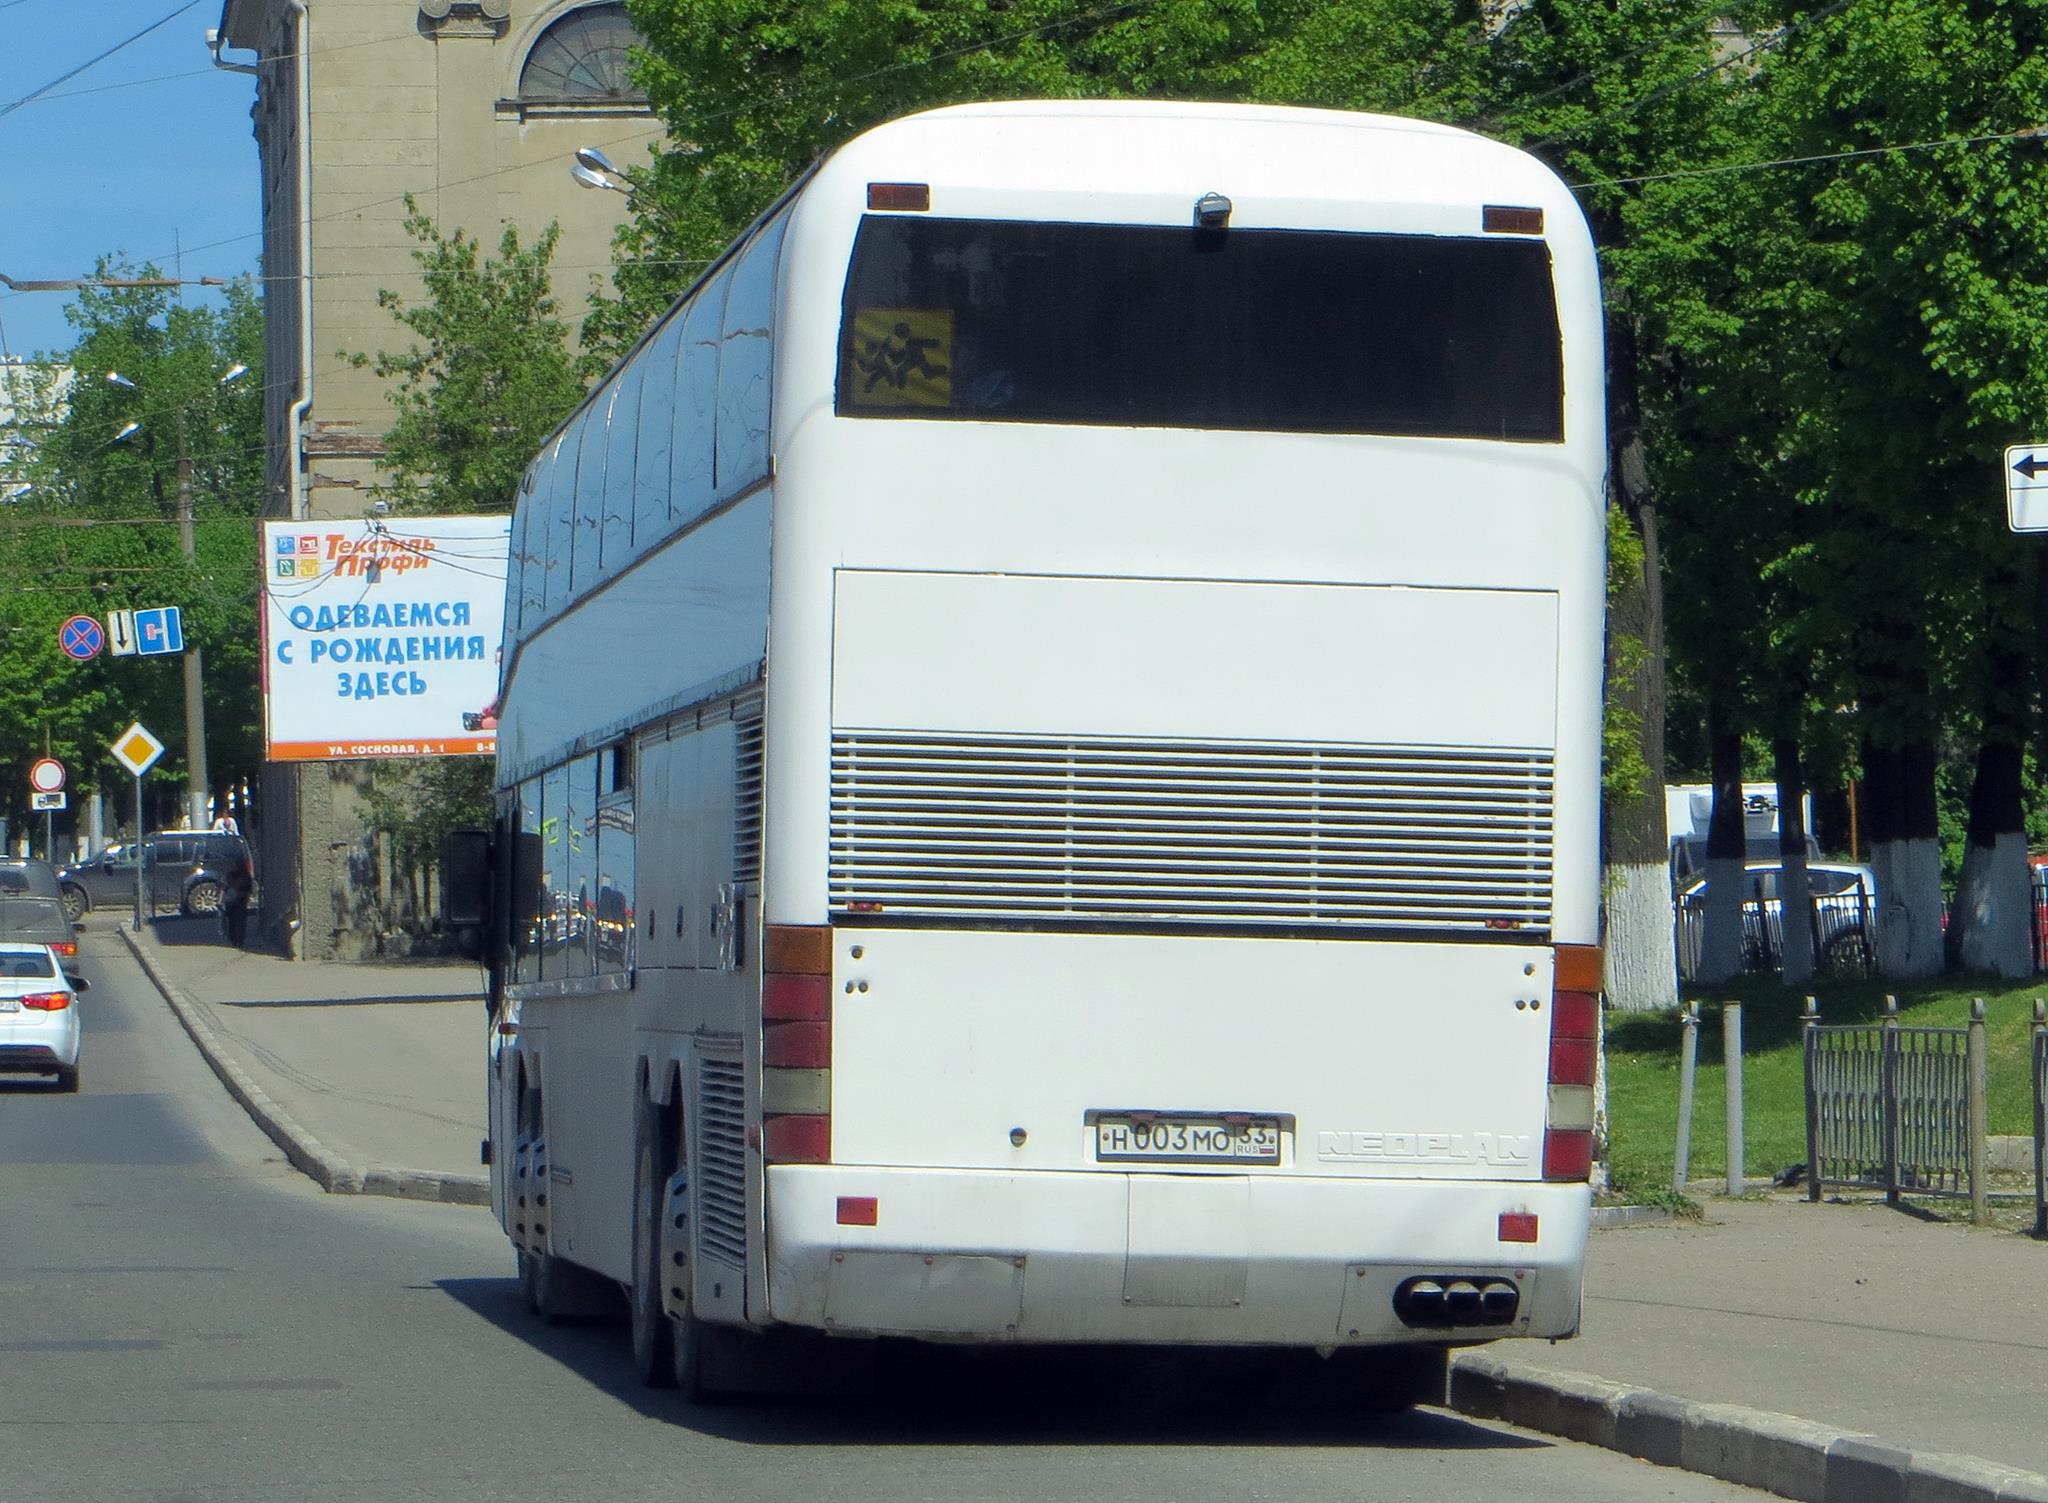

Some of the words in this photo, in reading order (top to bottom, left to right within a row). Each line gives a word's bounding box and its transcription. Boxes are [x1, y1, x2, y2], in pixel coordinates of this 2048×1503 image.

[325, 534, 436, 560] Текстиль
[334, 555, 431, 577] Профи
[290, 602, 470, 631] ОДЕВАЕМСЯ
[277, 640, 293, 664] С
[311, 637, 485, 665] РОЖДЕНИЯ
[338, 672, 427, 699] ЗДЕСЬ
[328, 746, 347, 755] УЛ.
[1318, 1131, 1529, 1161] NEOPLAN
